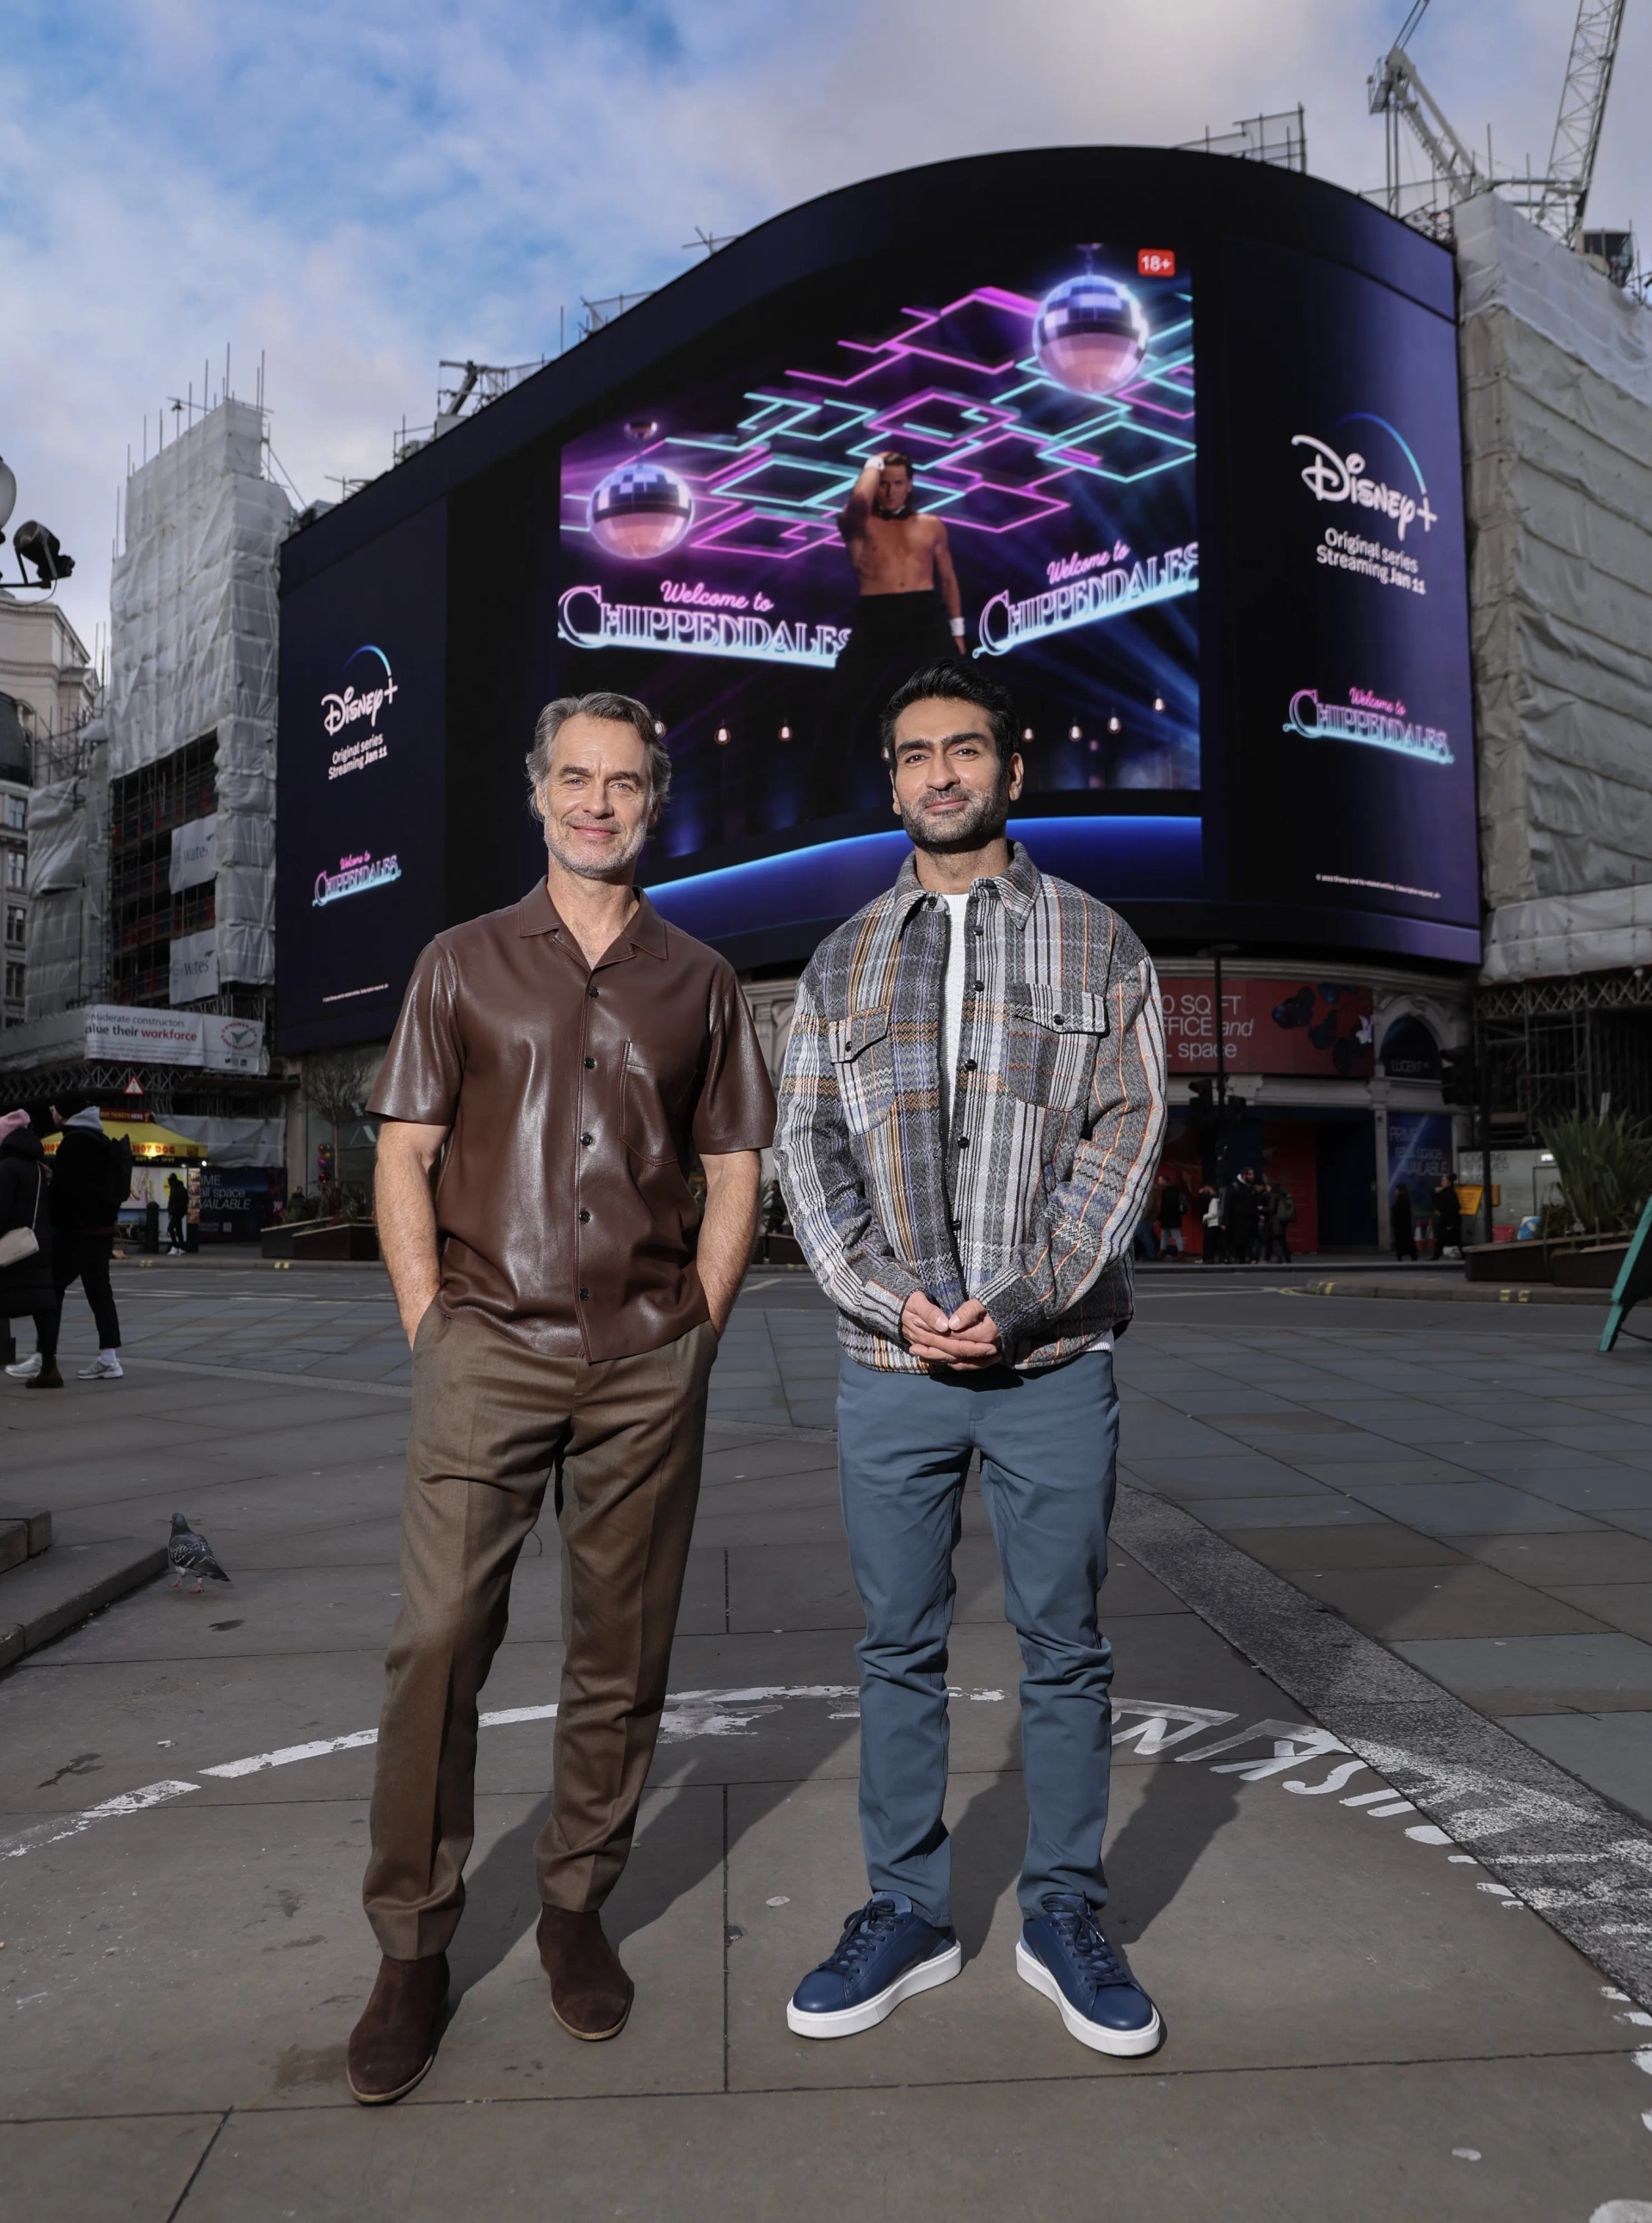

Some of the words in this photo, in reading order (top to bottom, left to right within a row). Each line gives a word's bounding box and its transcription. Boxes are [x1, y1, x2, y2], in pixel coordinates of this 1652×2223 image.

[1140, 254, 1172, 272] 18+
[1291, 434, 1438, 541] Disney+
[1325, 527, 1380, 560] Original
[1381, 547, 1419, 574] series
[1047, 549, 1111, 586] Welcome
[1110, 539, 1131, 568] to
[1316, 545, 1389, 585] Streaming
[1390, 567, 1412, 590] Jan
[661, 580, 749, 610] Welcome
[753, 591, 774, 613] to
[321, 677, 398, 736] Disney+
[1349, 687, 1393, 713] Welcome
[1395, 699, 1407, 716] to
[332, 741, 360, 765] Original
[360, 734, 384, 752] series
[328, 755, 364, 780] Streaming
[364, 749, 378, 765] Jan
[379, 745, 387, 759] 11
[183, 960, 209, 977] Wtes
[1180, 995, 1211, 1015] SQ
[133, 1017, 185, 1028] constructors
[1221, 1018, 1254, 1038] and
[113, 1024, 139, 1037] their
[141, 1028, 197, 1042] workforce
[1177, 1042, 1237, 1062] space
[199, 1174, 221, 1186] IME
[199, 1198, 251, 1210] VAILABLE
[213, 1189, 246, 1201] space
